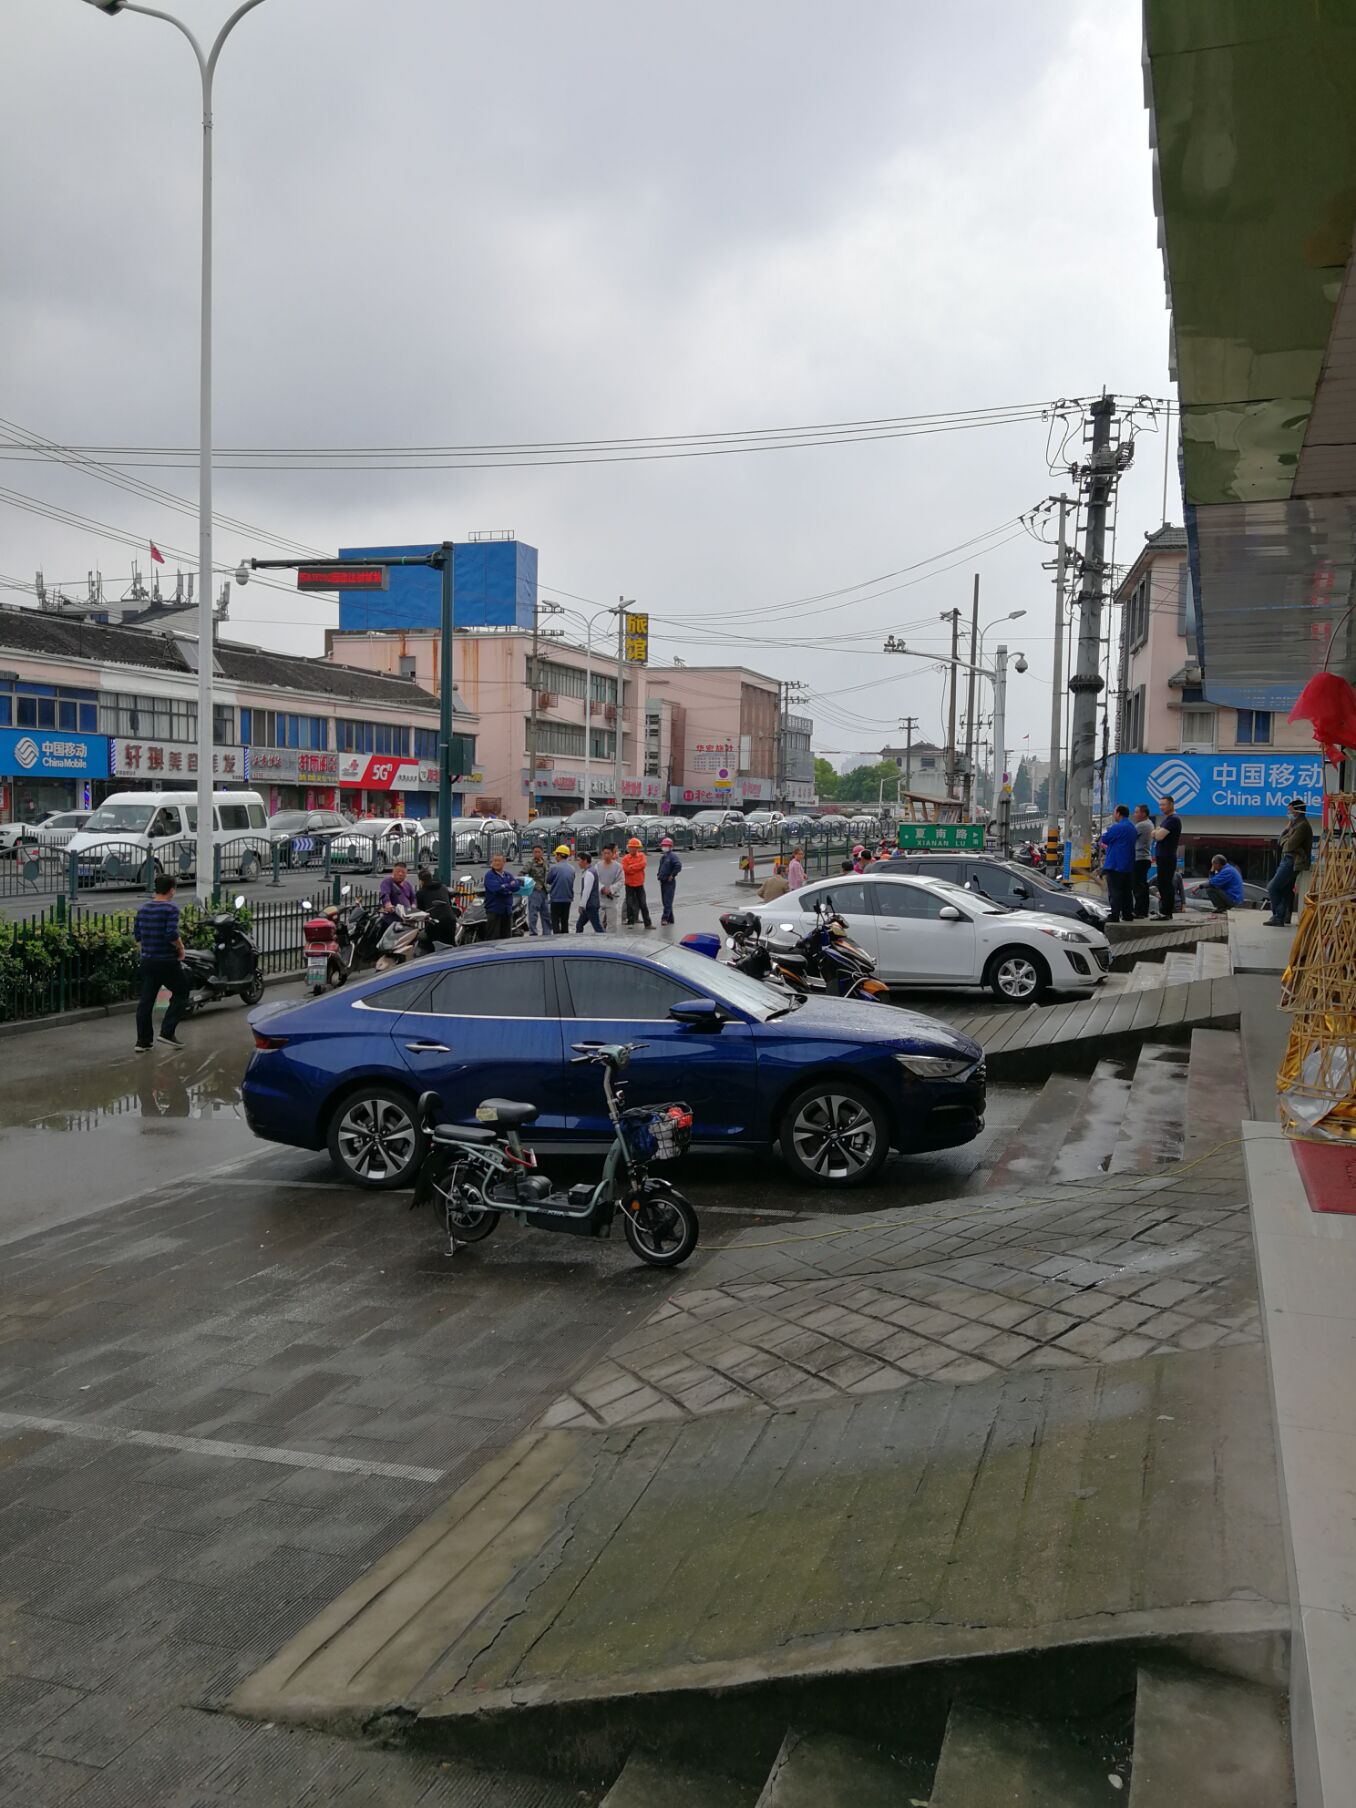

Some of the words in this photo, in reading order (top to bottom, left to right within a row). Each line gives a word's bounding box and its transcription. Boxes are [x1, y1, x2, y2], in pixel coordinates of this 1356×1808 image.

[42, 741, 88, 758] 中国移动
[42, 757, 65, 768] China
[65, 758, 87, 769] Mobile
[1213, 762, 1323, 788] 中国移动
[1212, 790, 1261, 806] China
[1266, 791, 1322, 807] Mobile
[915, 828, 968, 840] 夏南路
